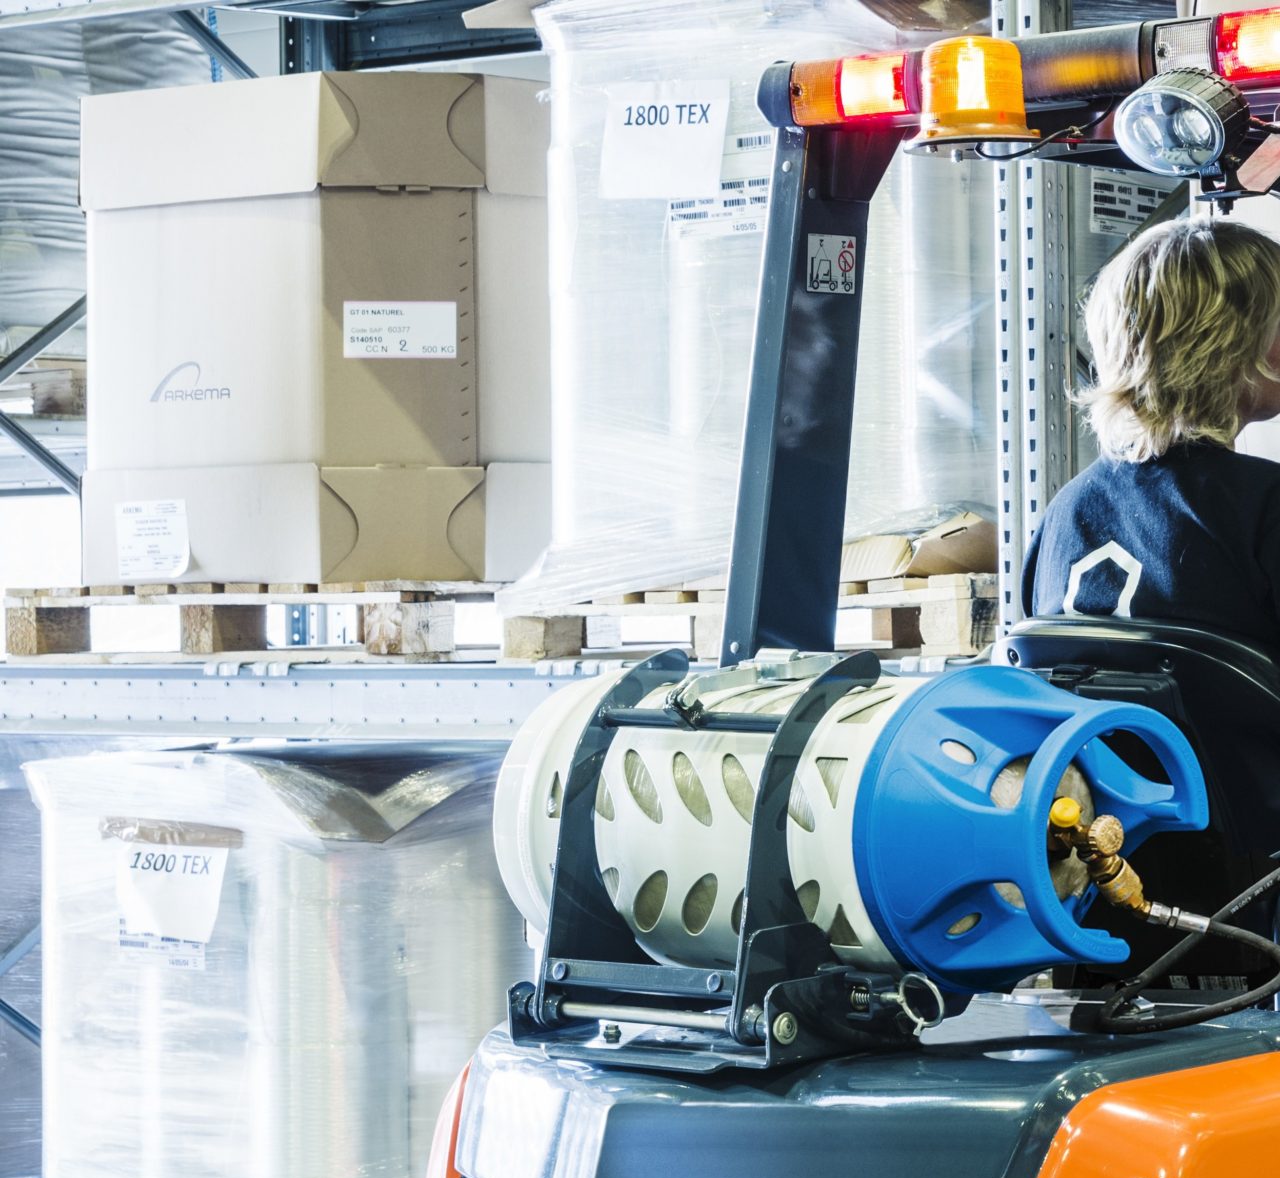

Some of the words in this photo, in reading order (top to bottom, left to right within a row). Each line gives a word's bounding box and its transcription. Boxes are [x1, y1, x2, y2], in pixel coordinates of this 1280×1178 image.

[623, 105, 669, 126] 1800
[675, 103, 711, 124] TEX
[387, 326, 411, 334] 60377
[365, 345, 379, 353] CC
[381, 345, 388, 353] N
[399, 340, 408, 352] 2
[440, 345, 455, 353] KG
[164, 387, 231, 401] ARKEMA
[130, 851, 177, 873] 1800
[182, 855, 212, 875] TEX
